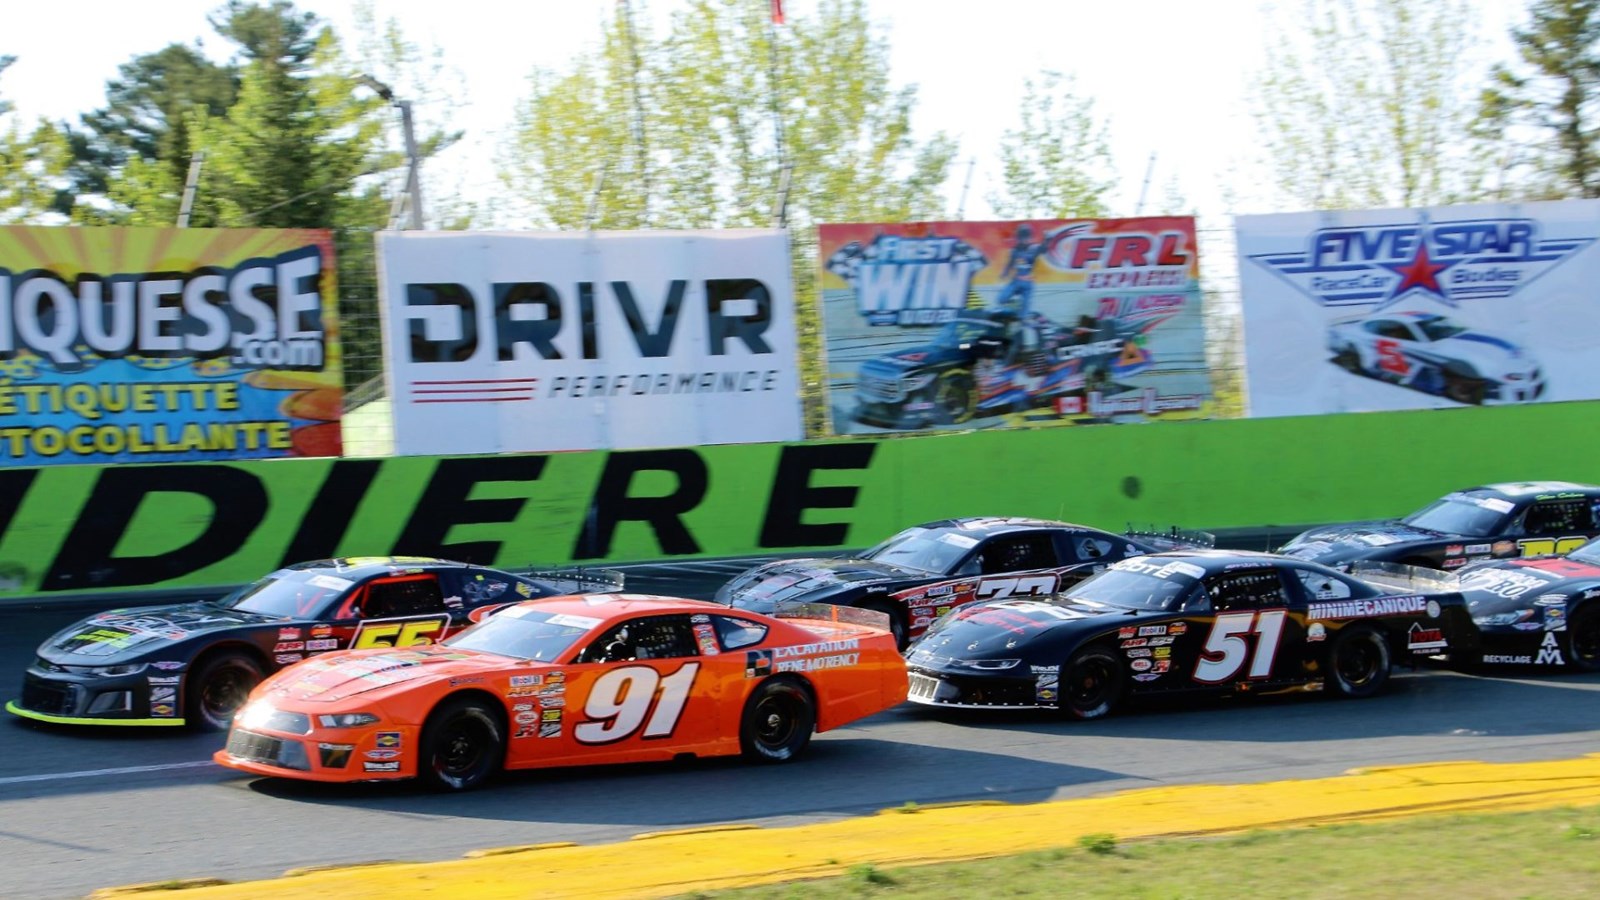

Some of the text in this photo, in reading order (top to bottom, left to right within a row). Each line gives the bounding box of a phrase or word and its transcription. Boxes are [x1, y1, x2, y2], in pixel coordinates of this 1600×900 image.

[877, 235, 958, 261] FIRST
[1071, 233, 1188, 270] FRL
[1312, 222, 1533, 273] FIVE STAR
[855, 262, 972, 312] WIN
[405, 277, 775, 363] DRIVR
[233, 337, 323, 366] .com
[1375, 338, 1410, 376] 5
[548, 369, 780, 399] PERFORMANCE
[0, 422, 293, 456] TOCOLLANTE
[774, 638, 859, 658] EXCAVATION
[1193, 607, 1289, 684] 51
[1482, 654, 1532, 664] RECYCLAGE
[574, 661, 701, 745] 91
